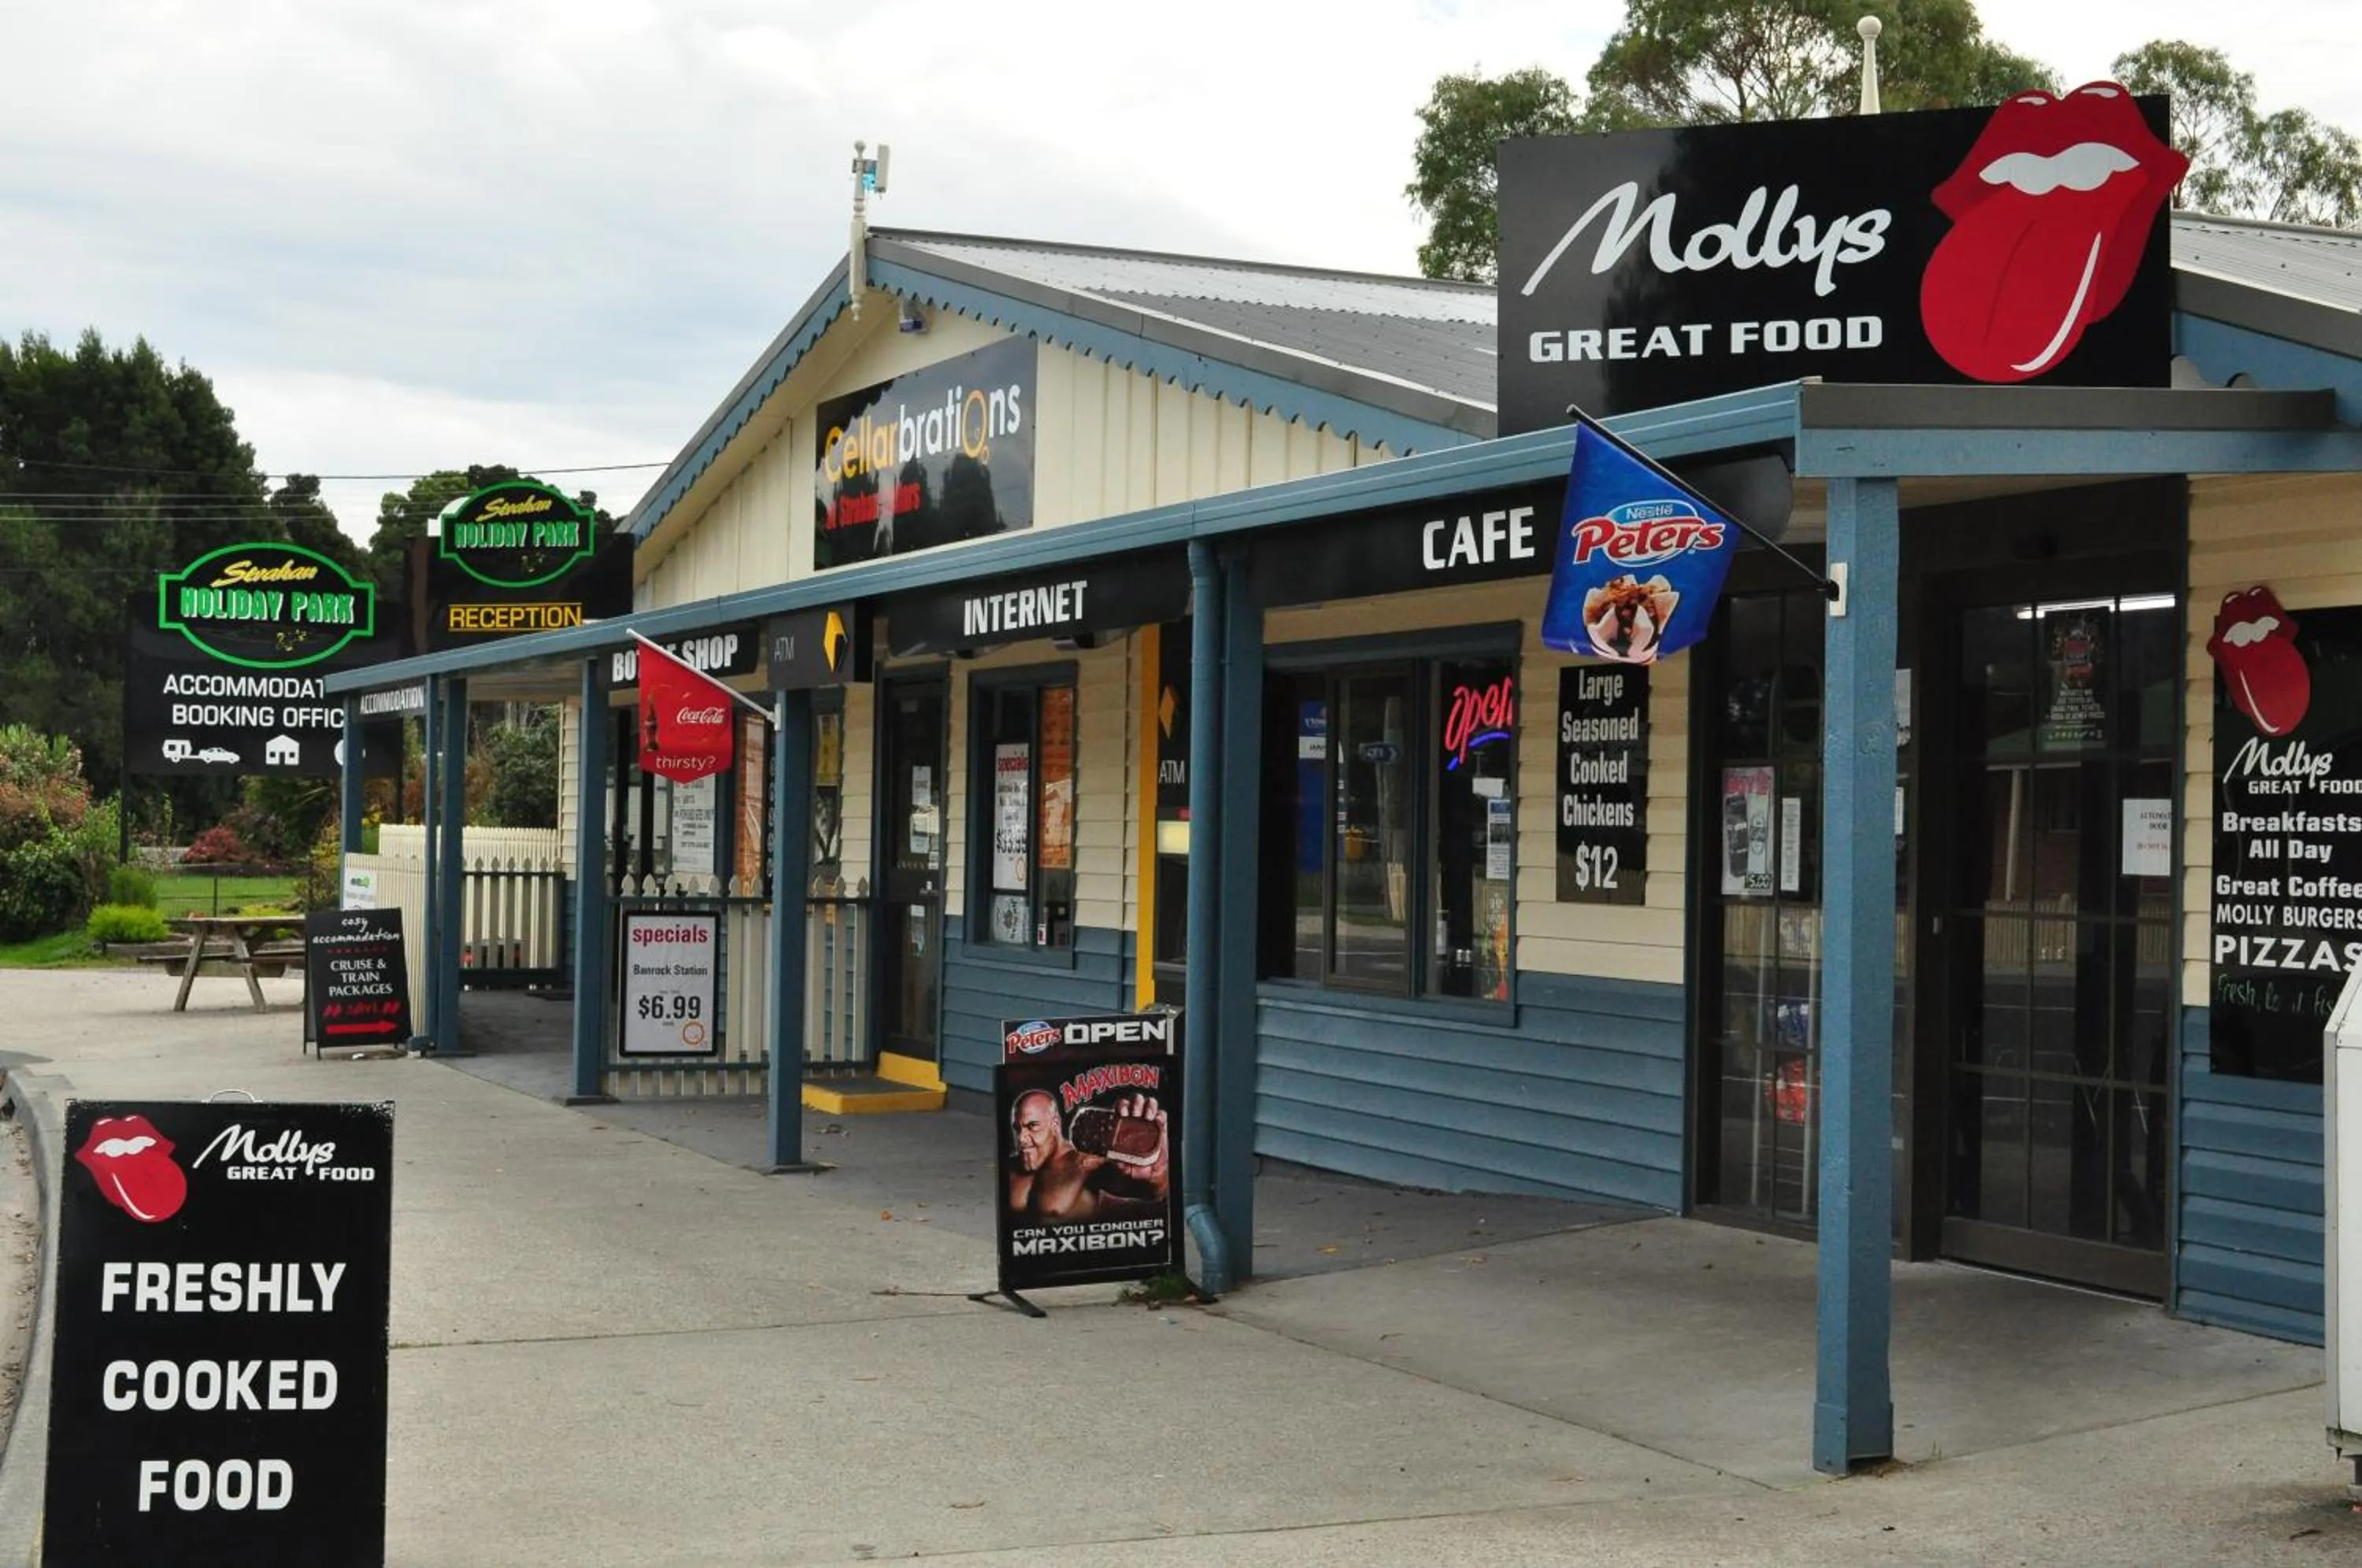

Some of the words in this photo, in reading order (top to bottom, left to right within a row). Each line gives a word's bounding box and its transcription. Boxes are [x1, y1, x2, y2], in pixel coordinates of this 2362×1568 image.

[1521, 180, 1892, 297] Mollys
[1529, 323, 1712, 363] GREAT
[1731, 316, 1883, 356] FOOD
[825, 384, 1020, 483] Cellarbrations
[454, 523, 528, 548] HOLIDAY
[533, 522, 580, 547] PARK
[1423, 506, 1535, 570] CAFE
[1572, 516, 1726, 564] Peters
[181, 587, 284, 621] HOLIDAY
[291, 592, 354, 623] PARK
[449, 606, 582, 628] RECEPTION
[964, 580, 1087, 636] INTERNET
[683, 634, 738, 671] SHOP
[775, 636, 795, 662] ATM
[163, 674, 324, 699] ACCOMMODAT
[359, 686, 424, 715] ACCOMMODATION
[1579, 669, 1623, 705] Large
[172, 704, 274, 727] BOOKING
[283, 708, 344, 728] OFFIC
[1562, 707, 1638, 742] Seasoned
[656, 756, 716, 771] thirsty?
[1158, 760, 1185, 784] ATM
[1571, 750, 1627, 784] Cooked
[2223, 736, 2333, 790] Mollys
[2248, 780, 2302, 794] GREAT
[1563, 793, 1634, 827] Chickens
[2222, 811, 2362, 832] Breakfasts
[2249, 839, 2279, 859] All
[2288, 839, 2333, 864] Day
[1576, 841, 1618, 891] $12
[2216, 875, 2280, 897] Great
[2288, 876, 2362, 898] Coffee
[2216, 903, 2275, 926] MOLLY
[632, 923, 708, 946] specials
[330, 958, 375, 971] CRUISE
[376, 958, 387, 969] &
[340, 971, 380, 982] TRAIN
[633, 964, 671, 976] Banrock
[672, 965, 708, 976] Station
[328, 983, 394, 997] PACKAGES
[639, 995, 701, 1019] $6.99
[1006, 1028, 1061, 1054] Peters
[1064, 1020, 1166, 1045] OPEN
[1060, 1064, 1159, 1111] MAXIBON
[193, 1123, 336, 1175] Mollys
[227, 1166, 294, 1181] GREAT
[319, 1166, 375, 1181] FOOD
[1013, 1227, 1046, 1239] CAN
[1053, 1225, 1084, 1236] YOU
[1089, 1219, 1164, 1233] CONQUER
[1013, 1230, 1164, 1257] MAXIBON?
[101, 1263, 346, 1313] FRESHLY
[102, 1359, 339, 1411] COOKED
[138, 1459, 294, 1513] FOOD
